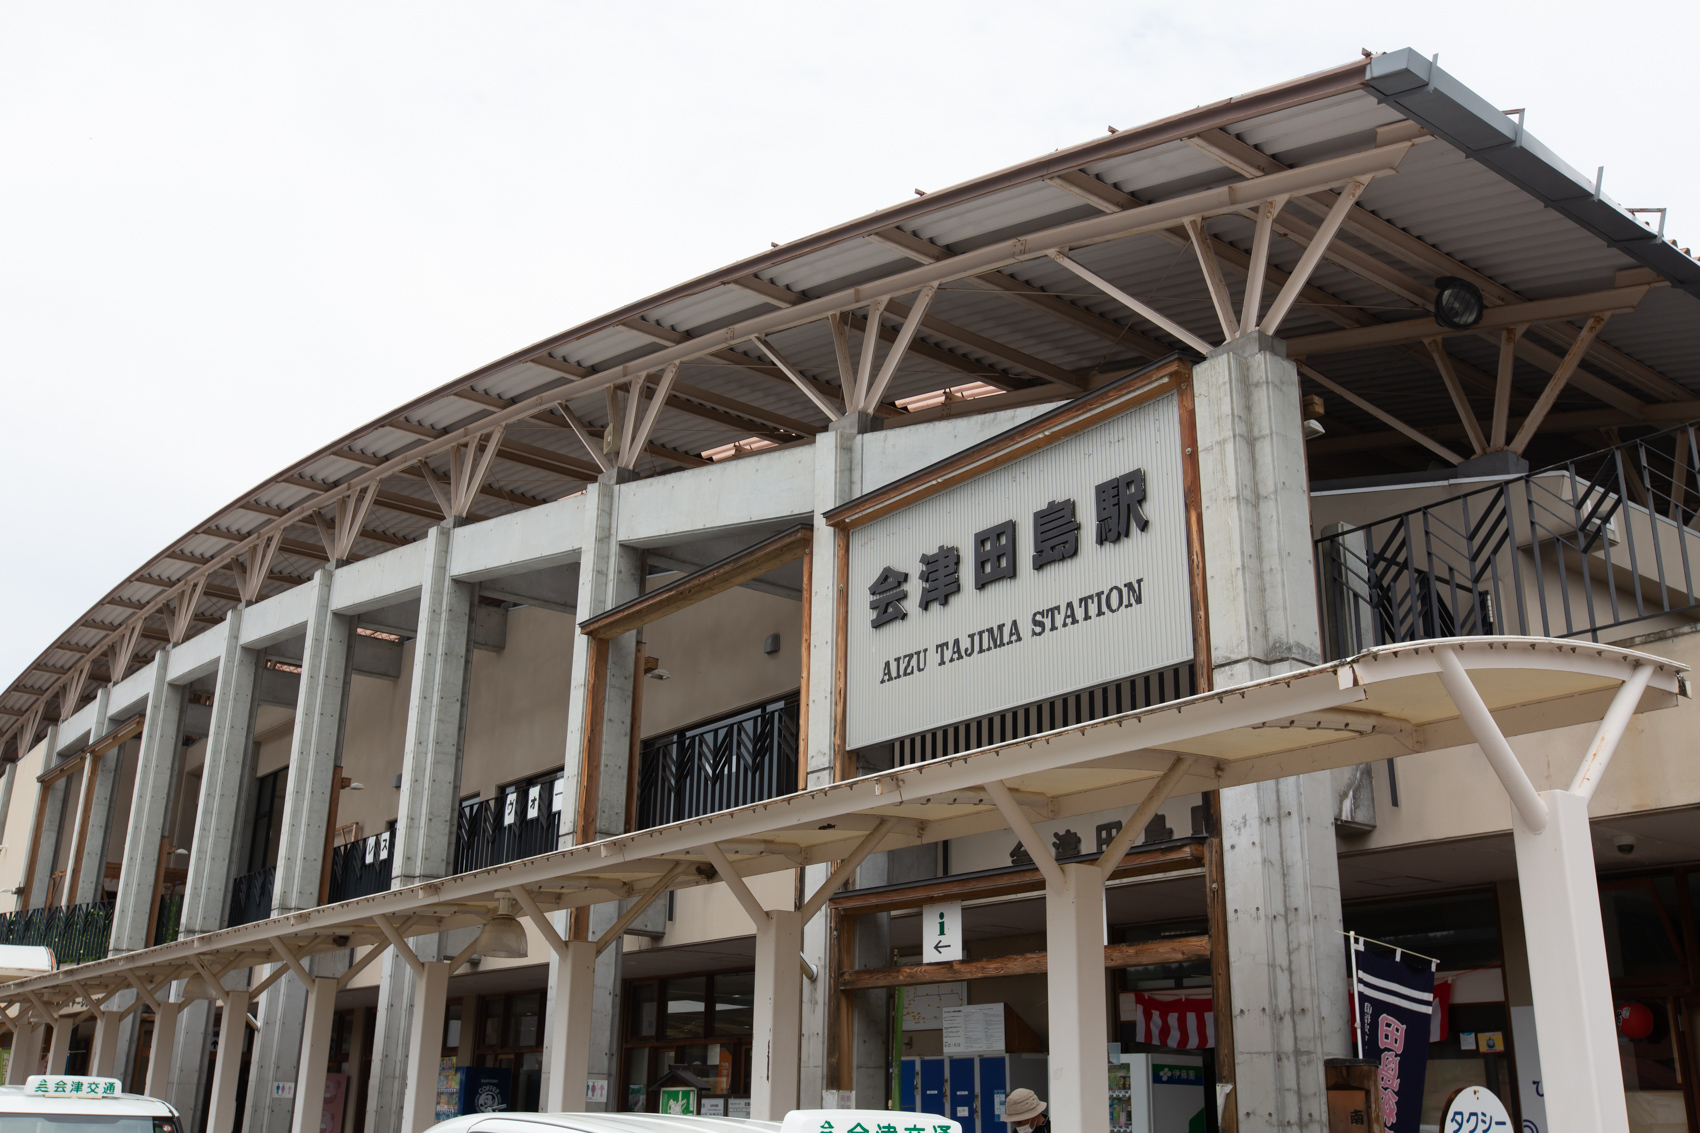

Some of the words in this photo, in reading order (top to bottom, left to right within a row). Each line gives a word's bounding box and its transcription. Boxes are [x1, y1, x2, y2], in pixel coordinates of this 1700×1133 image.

[868, 467, 1149, 629] 会津田島駅
[880, 647, 928, 685] AIZU
[935, 619, 1022, 667] TAJIMA
[1031, 577, 1144, 638] STATION
[53, 1079, 116, 1095] 会津交通
[478, 1085, 500, 1094] COFFEE
[1350, 1109, 1364, 1126] 南
[1451, 1111, 1506, 1133] タクシー
